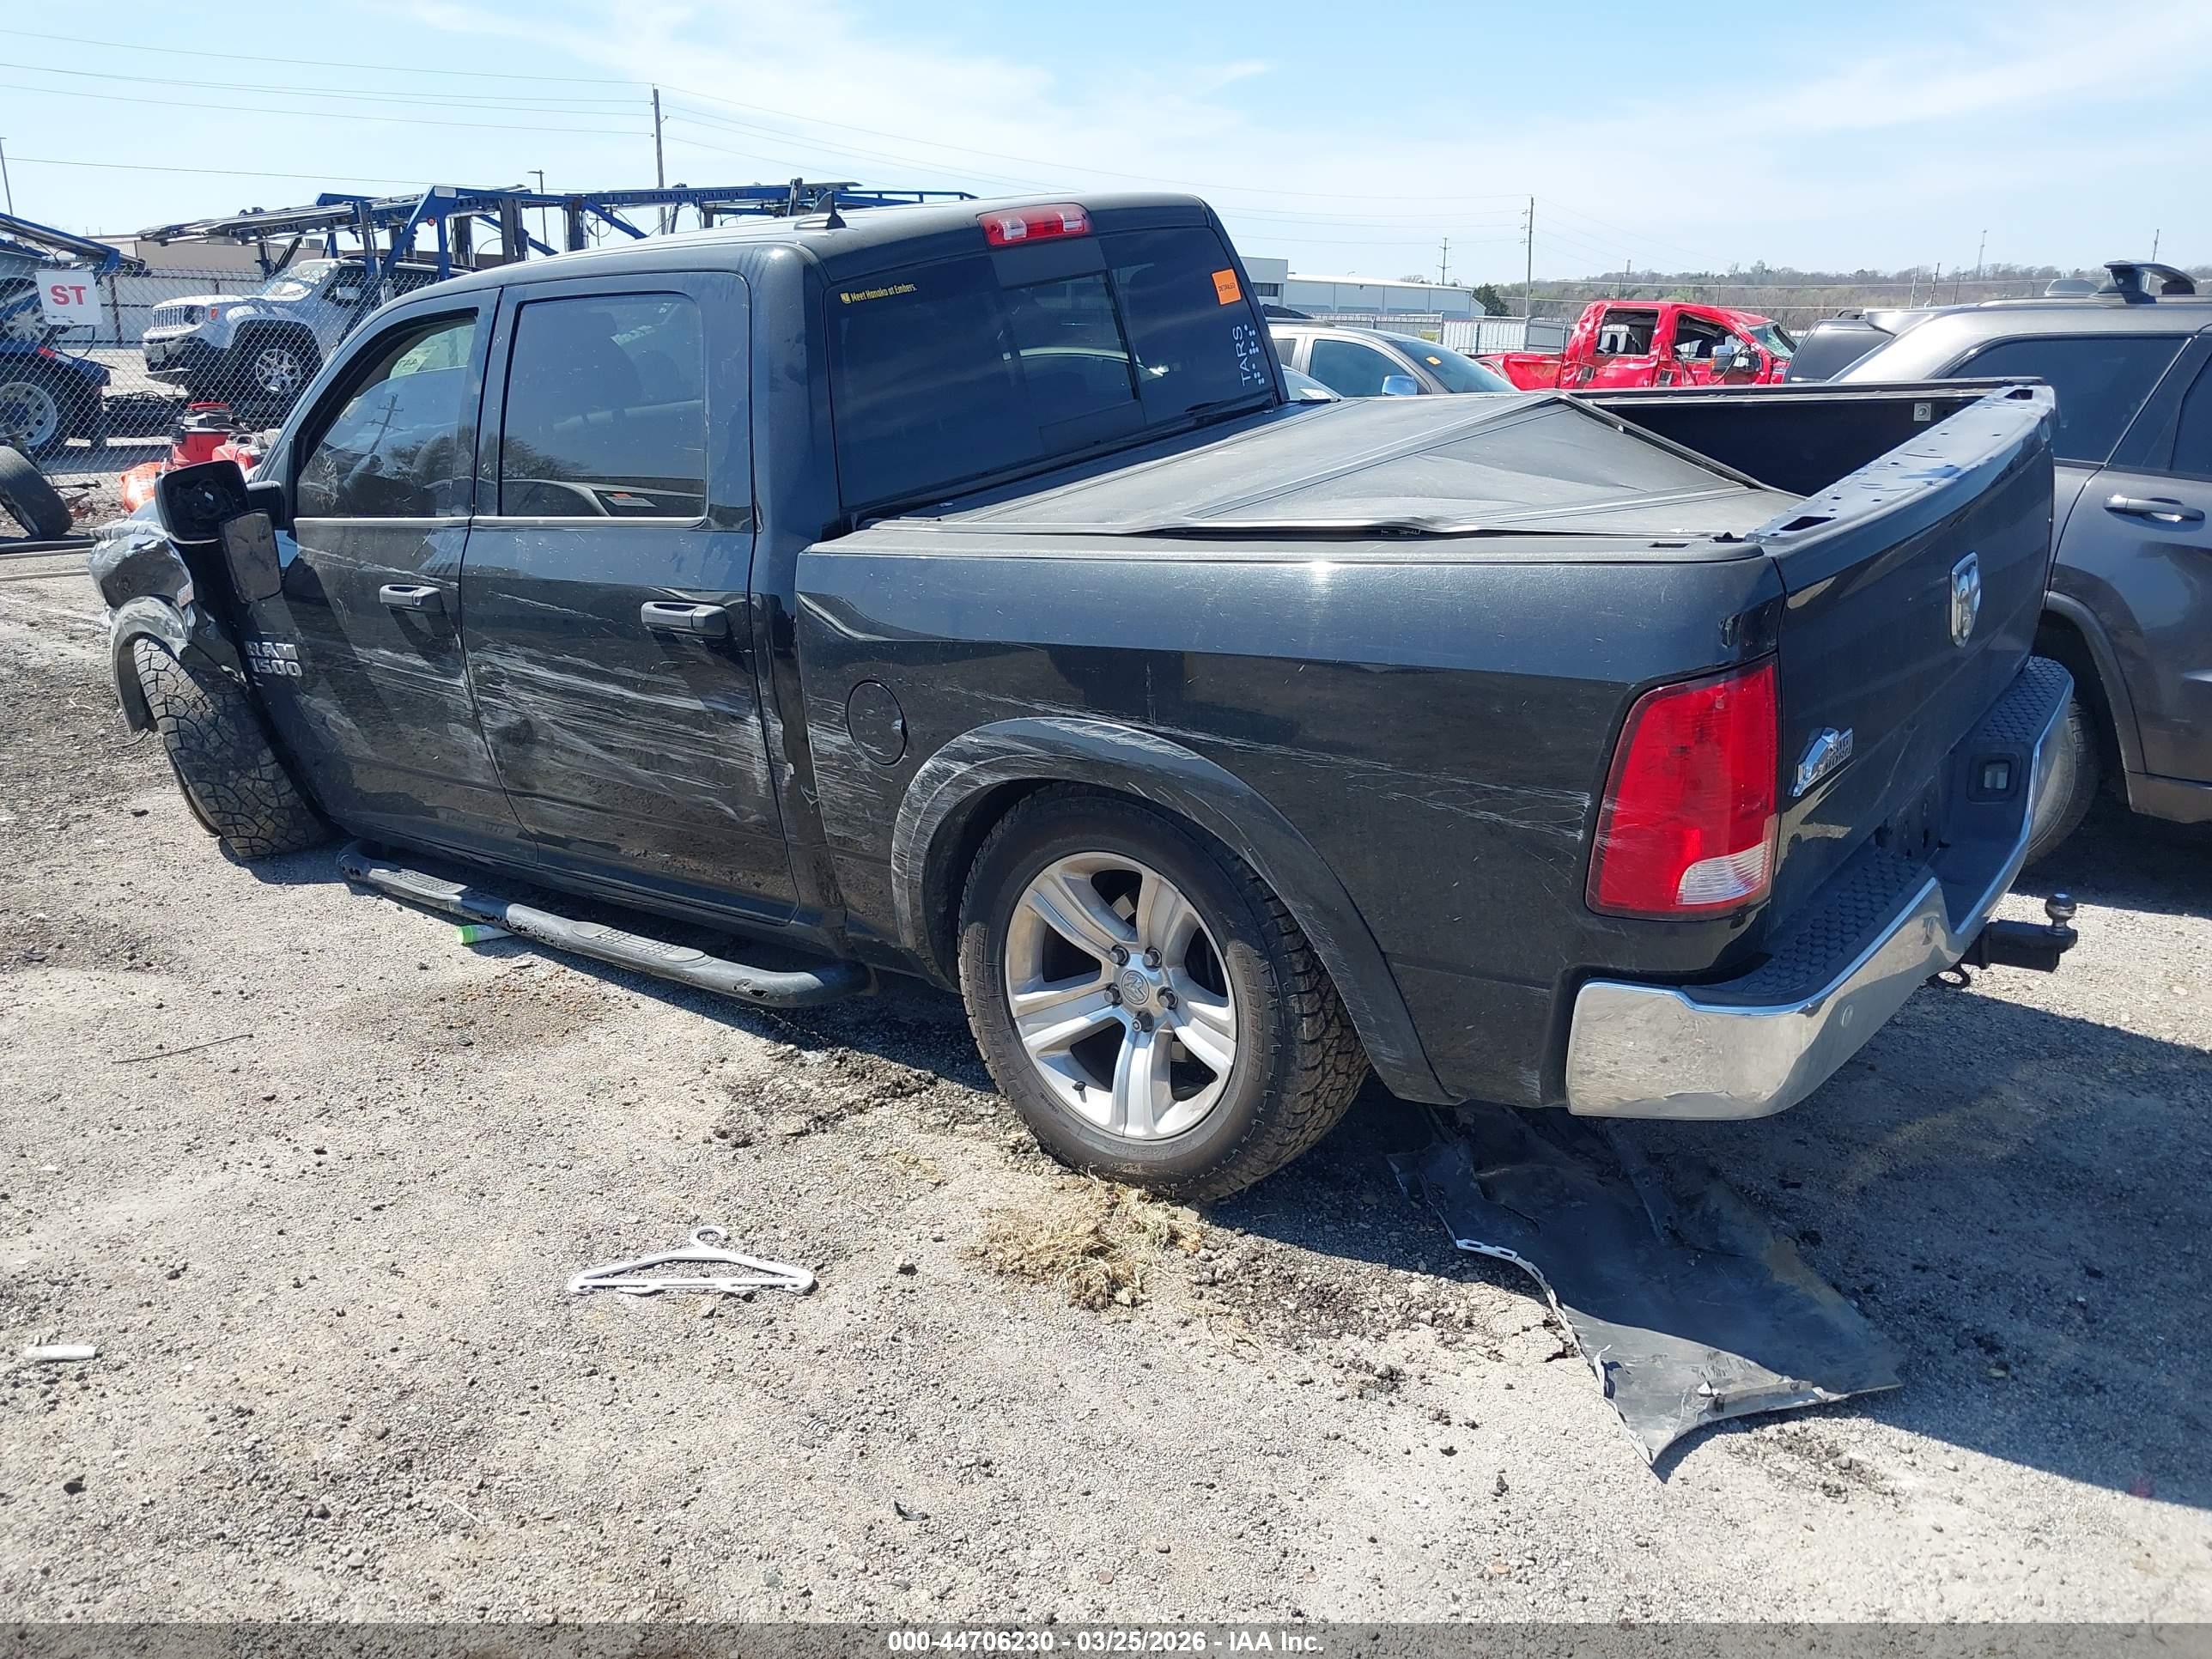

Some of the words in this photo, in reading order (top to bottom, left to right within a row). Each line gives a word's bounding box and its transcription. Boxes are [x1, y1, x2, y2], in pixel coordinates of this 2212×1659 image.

[50, 284, 88, 307] ST
[850, 291, 867, 302] Meet
[1233, 325, 1251, 386] TARS
[245, 641, 299, 660] RAM
[249, 658, 303, 677] 1500
